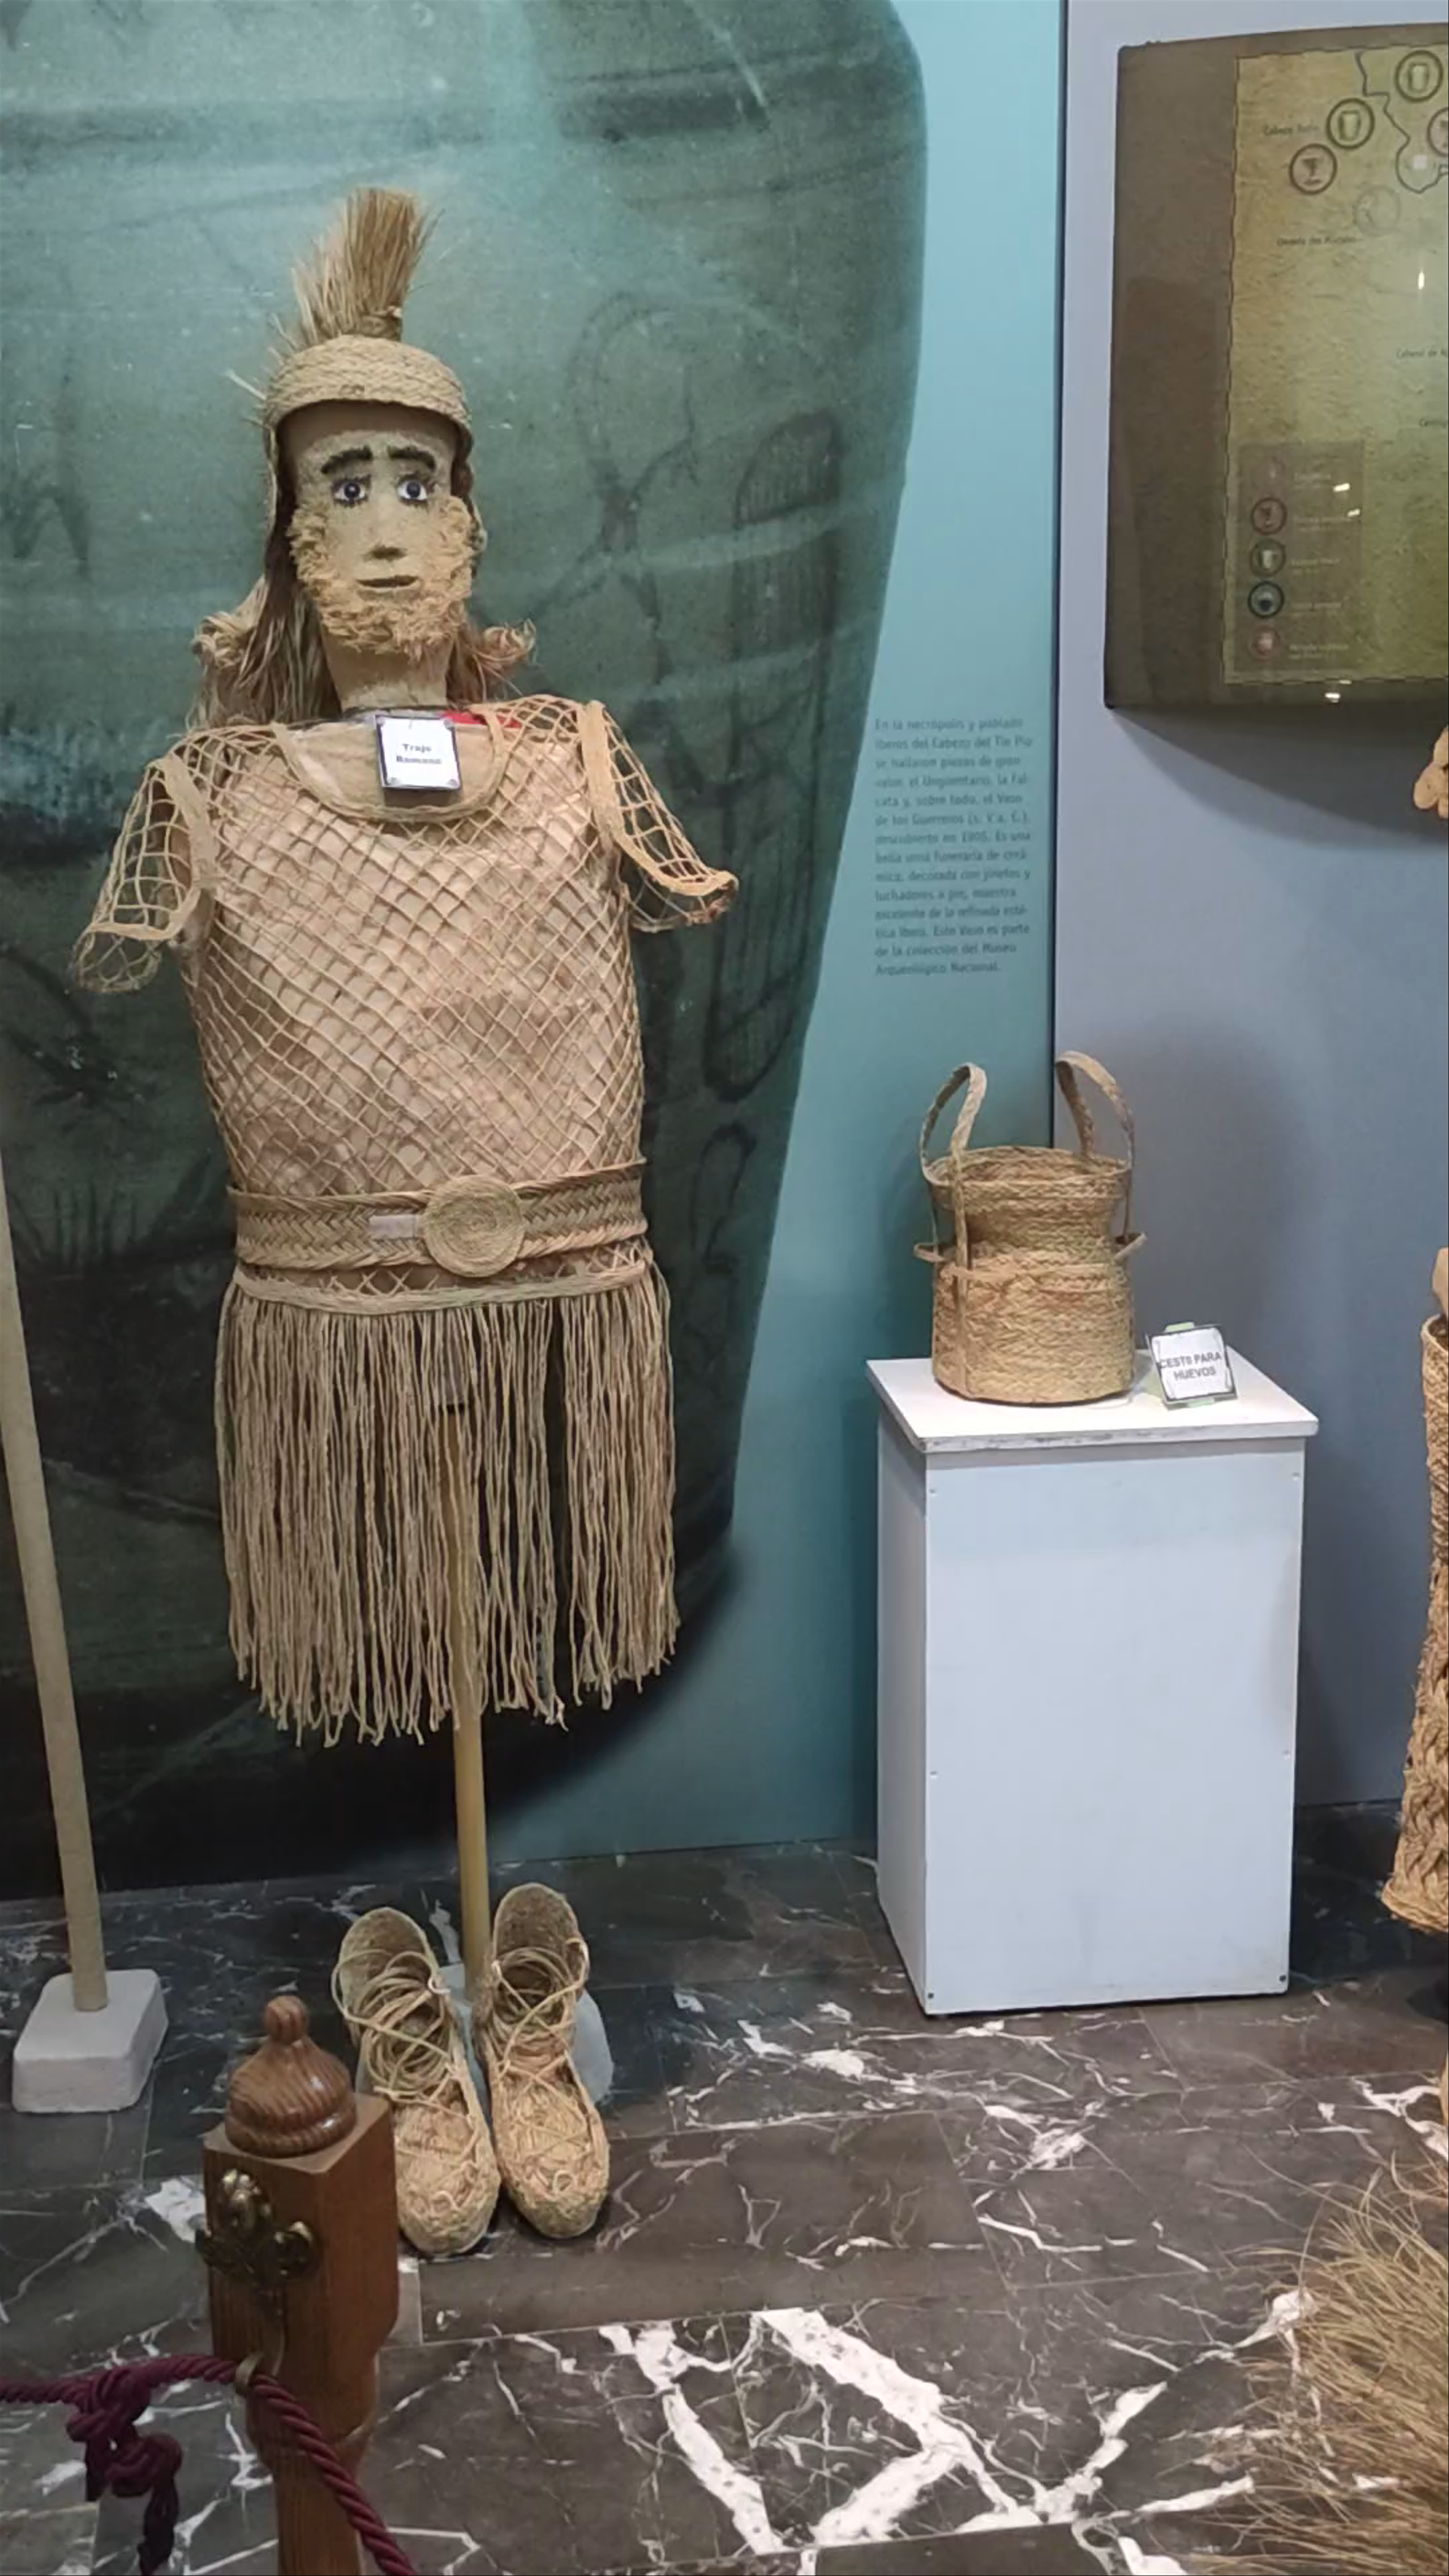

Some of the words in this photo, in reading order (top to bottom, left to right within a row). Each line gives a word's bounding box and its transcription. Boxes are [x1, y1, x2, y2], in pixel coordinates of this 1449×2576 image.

[875, 719, 888, 730] En
[893, 719, 903, 729] la
[912, 737, 928, 748] del
[932, 737, 971, 749] Cabezo
[974, 737, 991, 747] del
[891, 757, 936, 767] hallaron
[940, 758, 975, 769] piezas
[979, 756, 992, 766] de
[916, 794, 946, 807] sobre
[983, 793, 993, 804] el
[997, 794, 1023, 804] Vaso
[875, 815, 888, 826] de
[892, 816, 908, 825] los
[912, 812, 963, 825] Guerreros
[943, 834, 956, 842] en
[995, 831, 1007, 841] Es
[1011, 831, 1031, 841] una
[934, 850, 982, 861] funeraria
[987, 849, 1000, 860] de
[909, 869, 957, 881] decorada
[961, 870, 980, 880] con
[1024, 869, 1030, 880] y
[875, 890, 934, 901] luchadores
[973, 888, 1016, 898] muestra
[929, 907, 942, 918] de
[944, 907, 954, 917] la
[960, 926, 984, 935] Vaso
[1002, 924, 1030, 937] parte
[875, 946, 888, 956] de
[892, 944, 902, 955] la
[961, 943, 978, 954] del
[982, 943, 1016, 953] Museo
[875, 964, 946, 977] Arqueológico
[1193, 1351, 1222, 1364] PARA
[1173, 1366, 1217, 1381] HUEVOS
